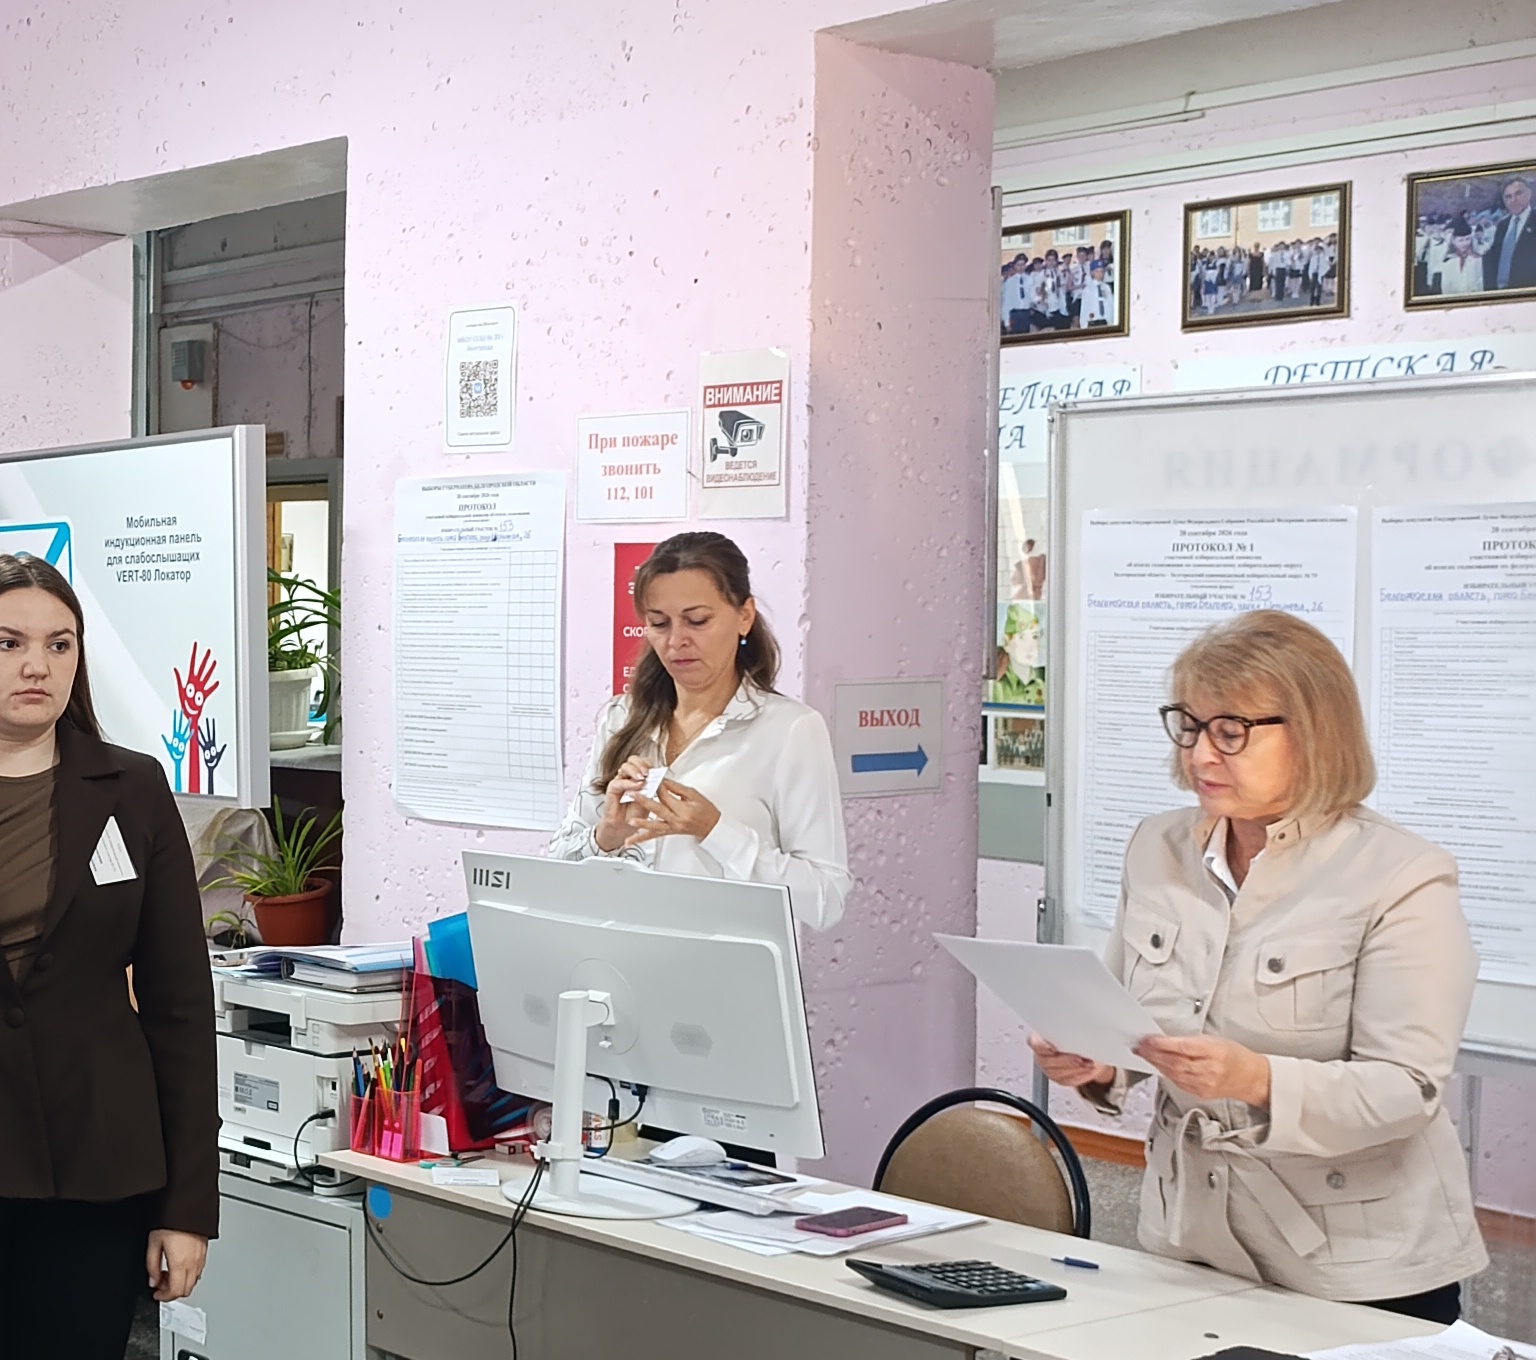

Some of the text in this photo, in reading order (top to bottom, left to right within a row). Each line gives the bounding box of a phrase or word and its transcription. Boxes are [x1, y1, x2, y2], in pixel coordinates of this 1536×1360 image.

[705, 383, 780, 406] ВНИМАНИЕ
[588, 433, 679, 454] При пожаре
[601, 462, 662, 477] звонить
[725, 460, 757, 471] ВЕДЕТСЯ
[706, 471, 776, 484] ВИДЕОНАБЛЮДЕНИЕ
[607, 486, 654, 502] 112, 101
[458, 502, 496, 512] ПРОТОКОЛ
[126, 515, 177, 529] Мобильная
[104, 533, 202, 550] индукционная панель
[1172, 542, 1233, 553] ПРОТОКОЛ
[106, 551, 200, 567] для слабослышащих
[116, 568, 191, 583] VERT-80 Локатор
[1249, 584, 1273, 601] 153
[858, 708, 920, 728] ВЫХОД
